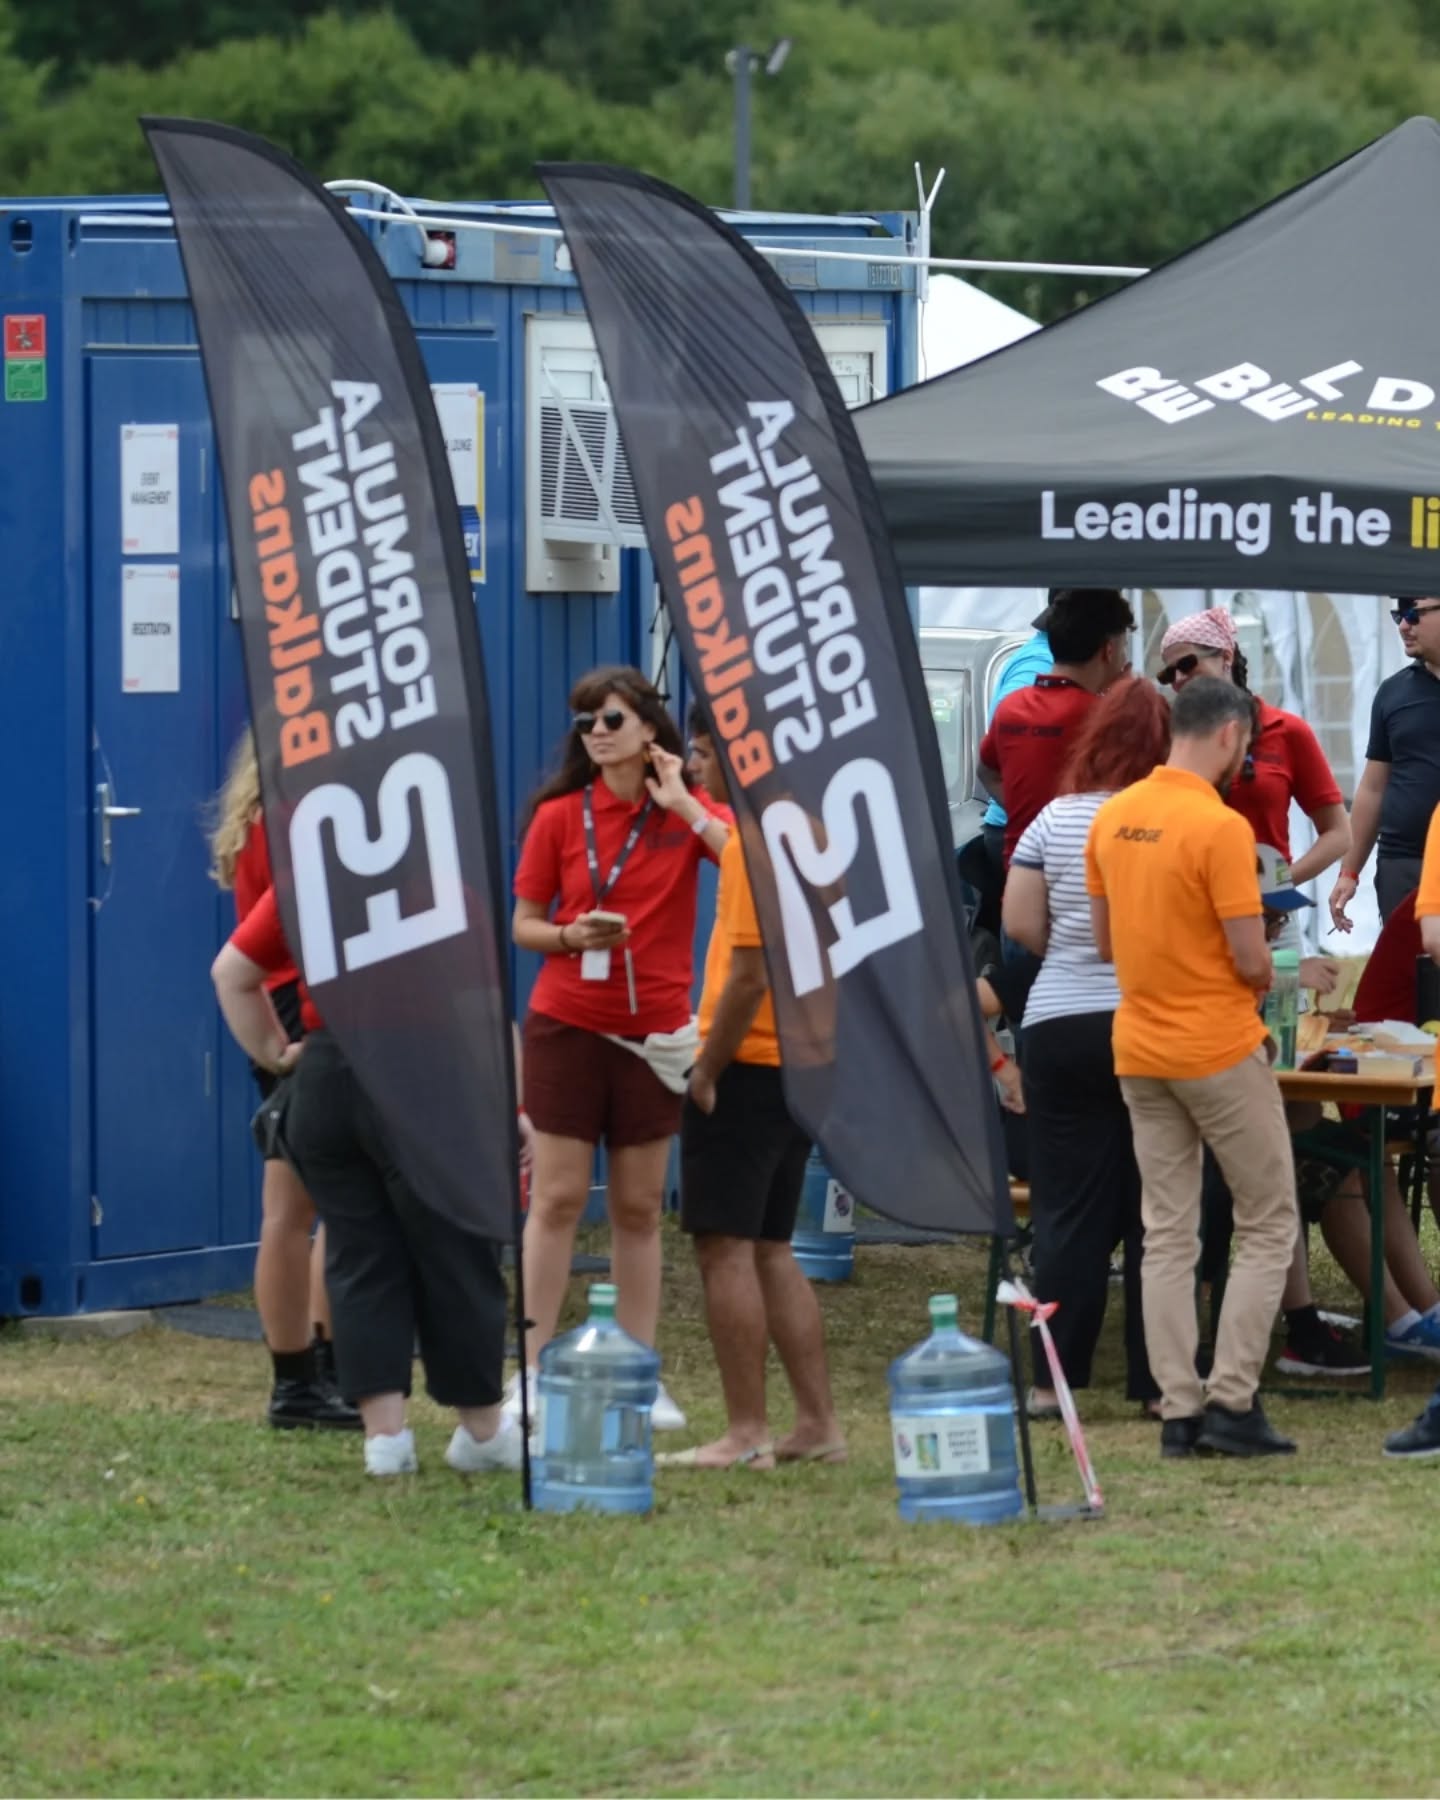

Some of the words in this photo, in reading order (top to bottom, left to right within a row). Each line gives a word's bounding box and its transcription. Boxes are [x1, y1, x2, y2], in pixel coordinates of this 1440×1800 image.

[1305, 410, 1422, 430] LEADING
[1040, 488, 1272, 556] Leading
[1290, 491, 1392, 547] the
[1113, 825, 1164, 843] JUDGE
